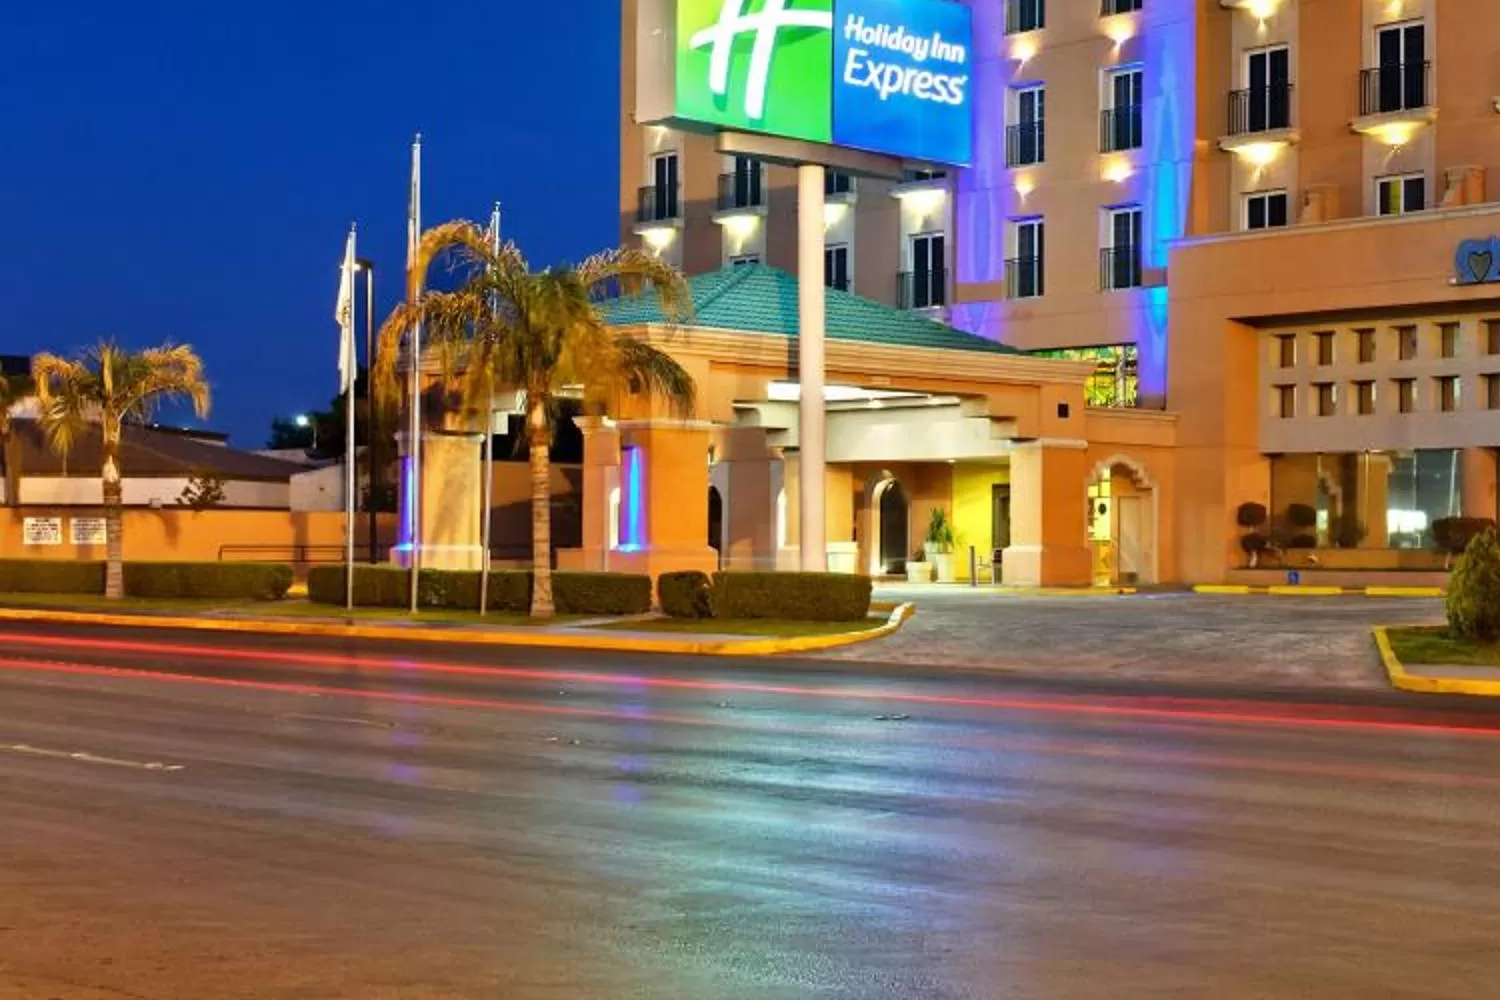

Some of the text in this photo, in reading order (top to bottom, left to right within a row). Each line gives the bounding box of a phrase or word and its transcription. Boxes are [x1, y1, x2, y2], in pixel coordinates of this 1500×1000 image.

[843, 13, 966, 65] Holiday Inn
[843, 47, 969, 105] Express
